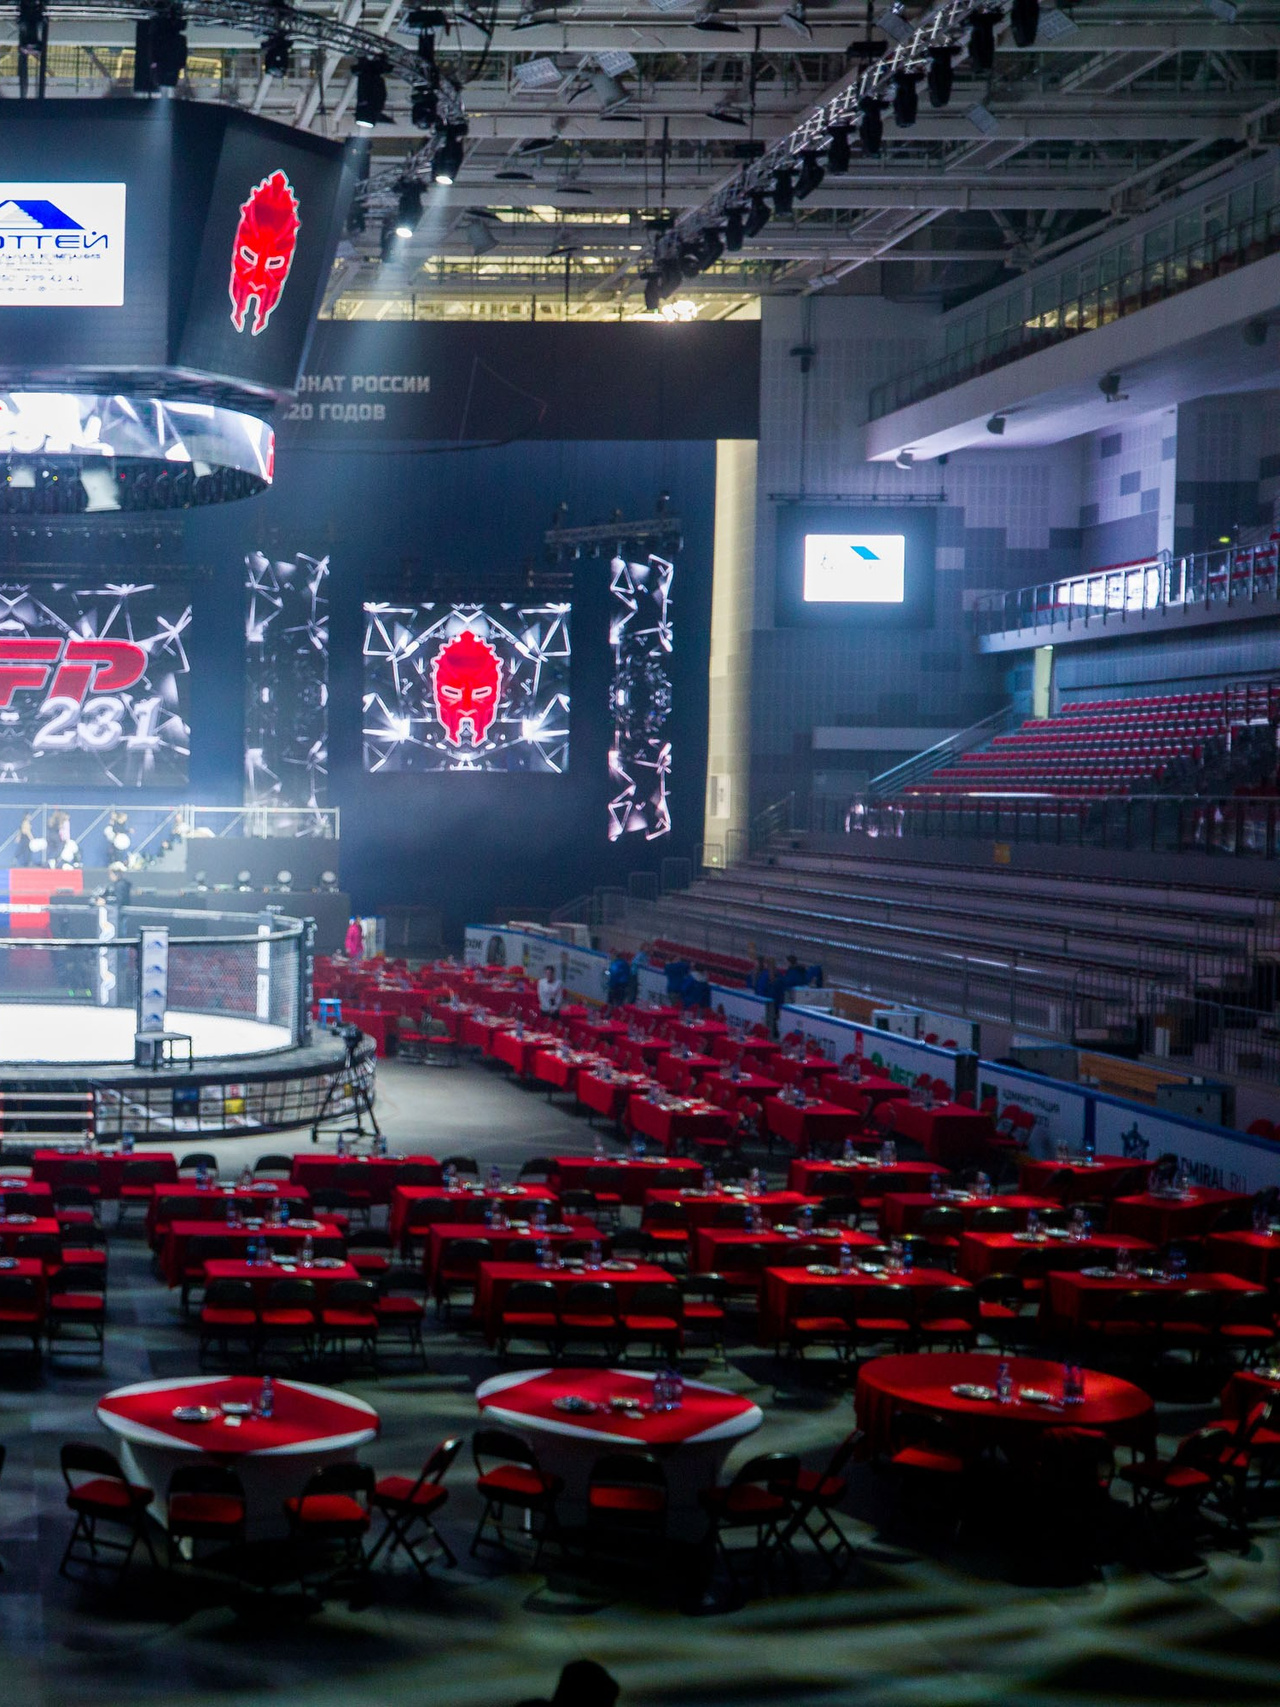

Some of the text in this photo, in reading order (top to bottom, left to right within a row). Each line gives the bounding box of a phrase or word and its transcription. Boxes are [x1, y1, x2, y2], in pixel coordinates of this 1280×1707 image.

[351, 375, 431, 393] РОССИИ
[320, 404, 386, 422] ГОДОВ
[32, 695, 163, 751] 231
